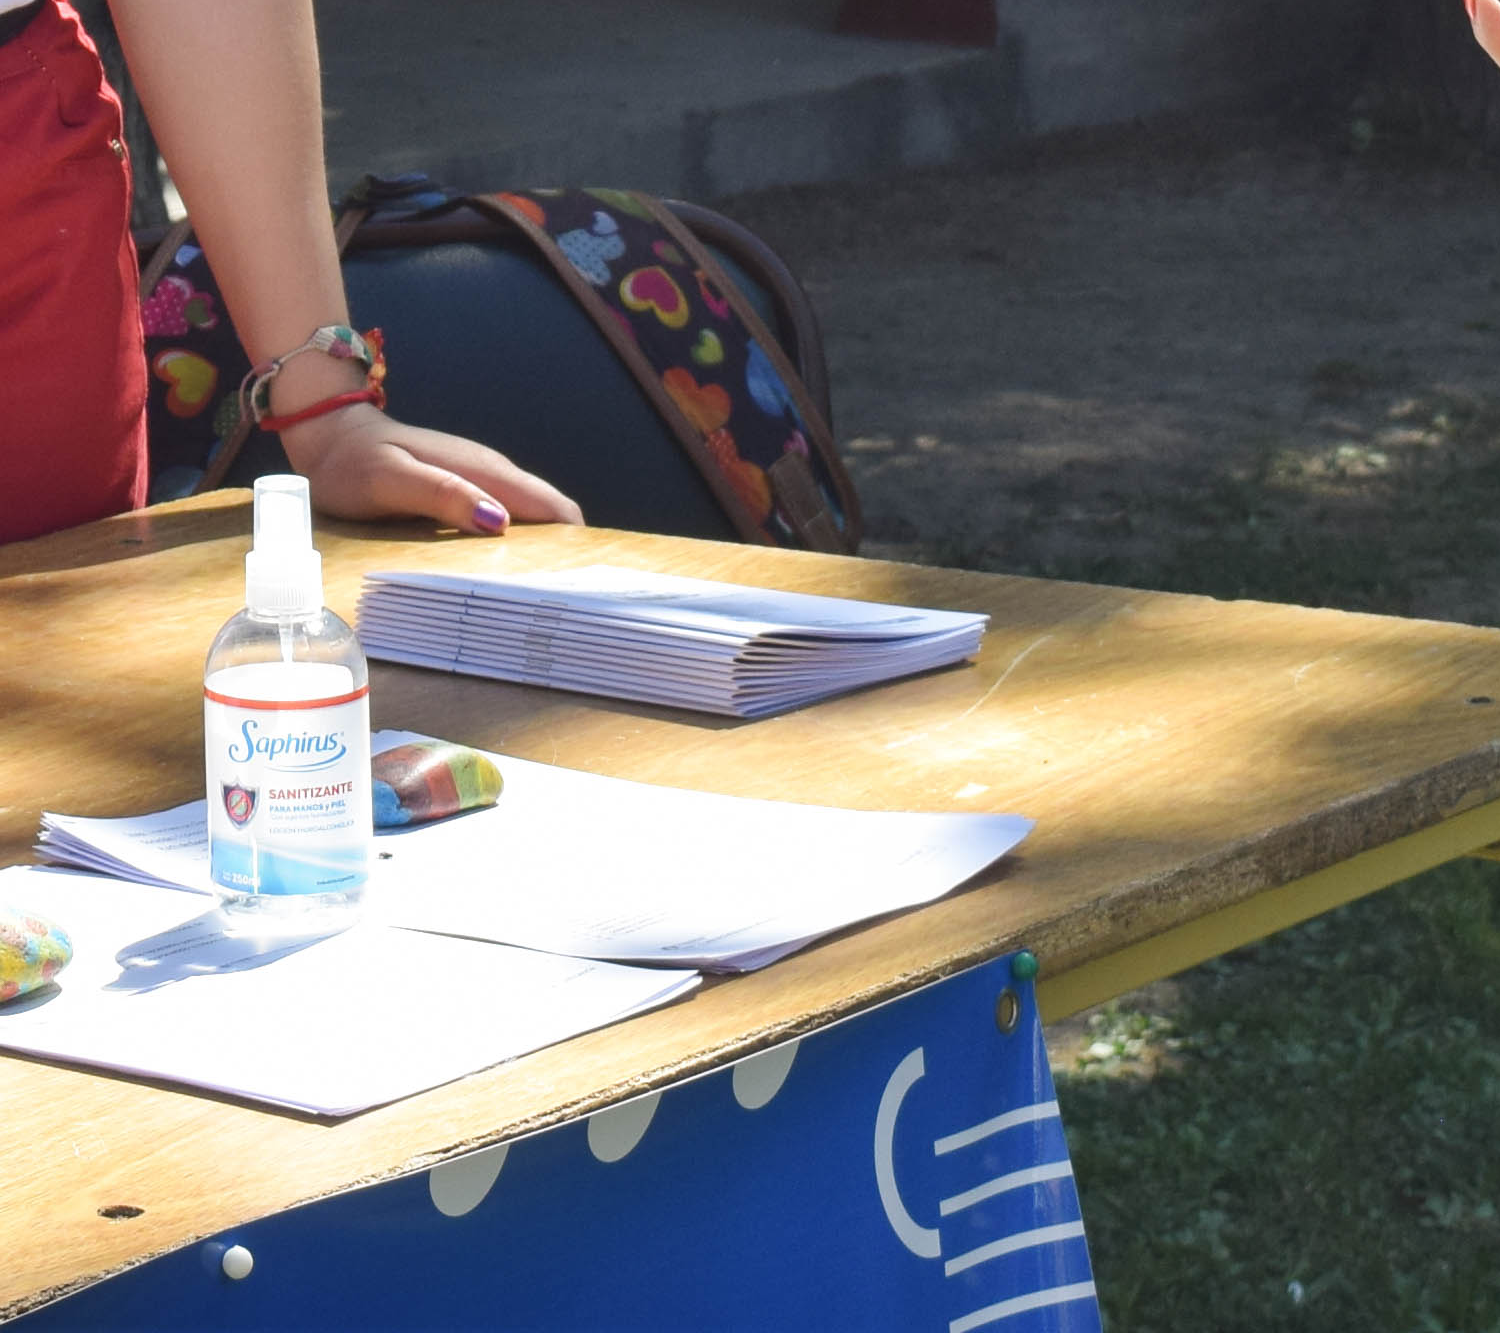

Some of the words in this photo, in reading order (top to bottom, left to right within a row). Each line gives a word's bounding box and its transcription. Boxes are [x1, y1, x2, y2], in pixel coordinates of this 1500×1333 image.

[228, 720, 340, 763] Saphirus
[268, 781, 353, 800] SANITIZANTE
[269, 804, 291, 813] PARA
[293, 802, 324, 812] MANOS
